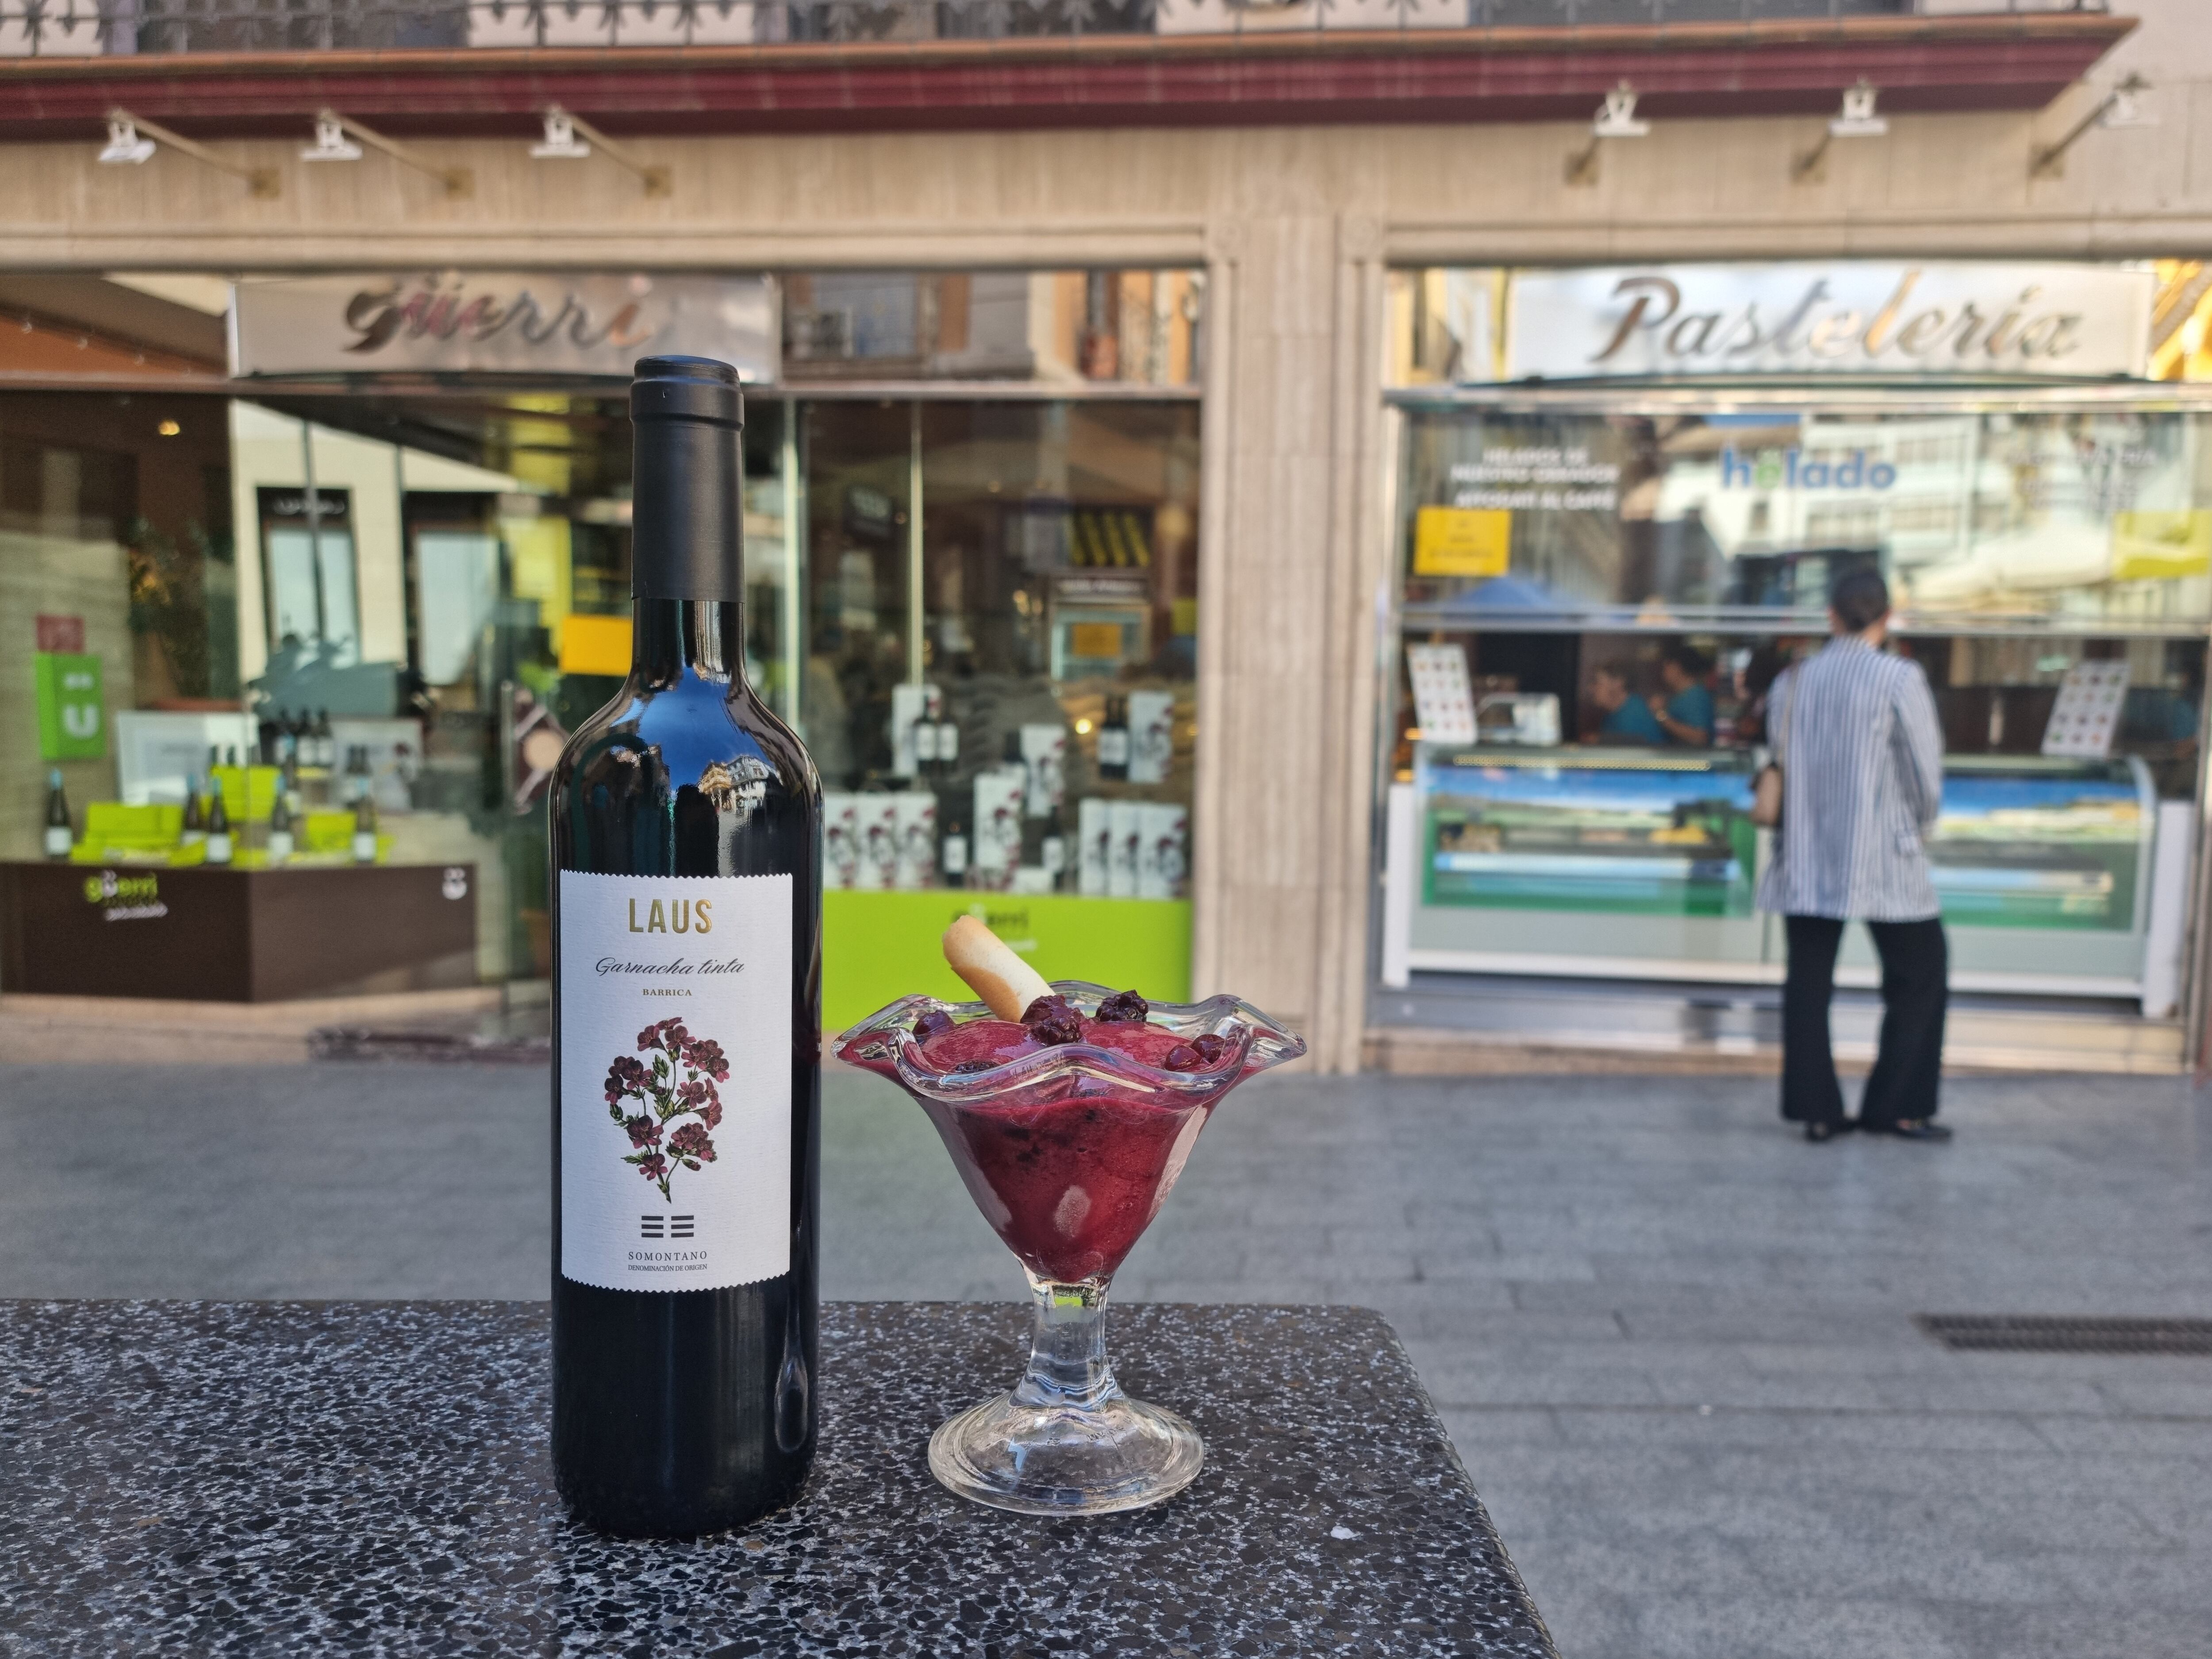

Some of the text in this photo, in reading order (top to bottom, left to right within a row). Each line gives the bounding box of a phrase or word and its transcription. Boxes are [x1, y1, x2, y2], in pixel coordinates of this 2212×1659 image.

[629, 898, 712, 934] LAUS
[595, 957, 744, 977] Garnacha tinta
[628, 1251, 707, 1261] SOMONTANO
